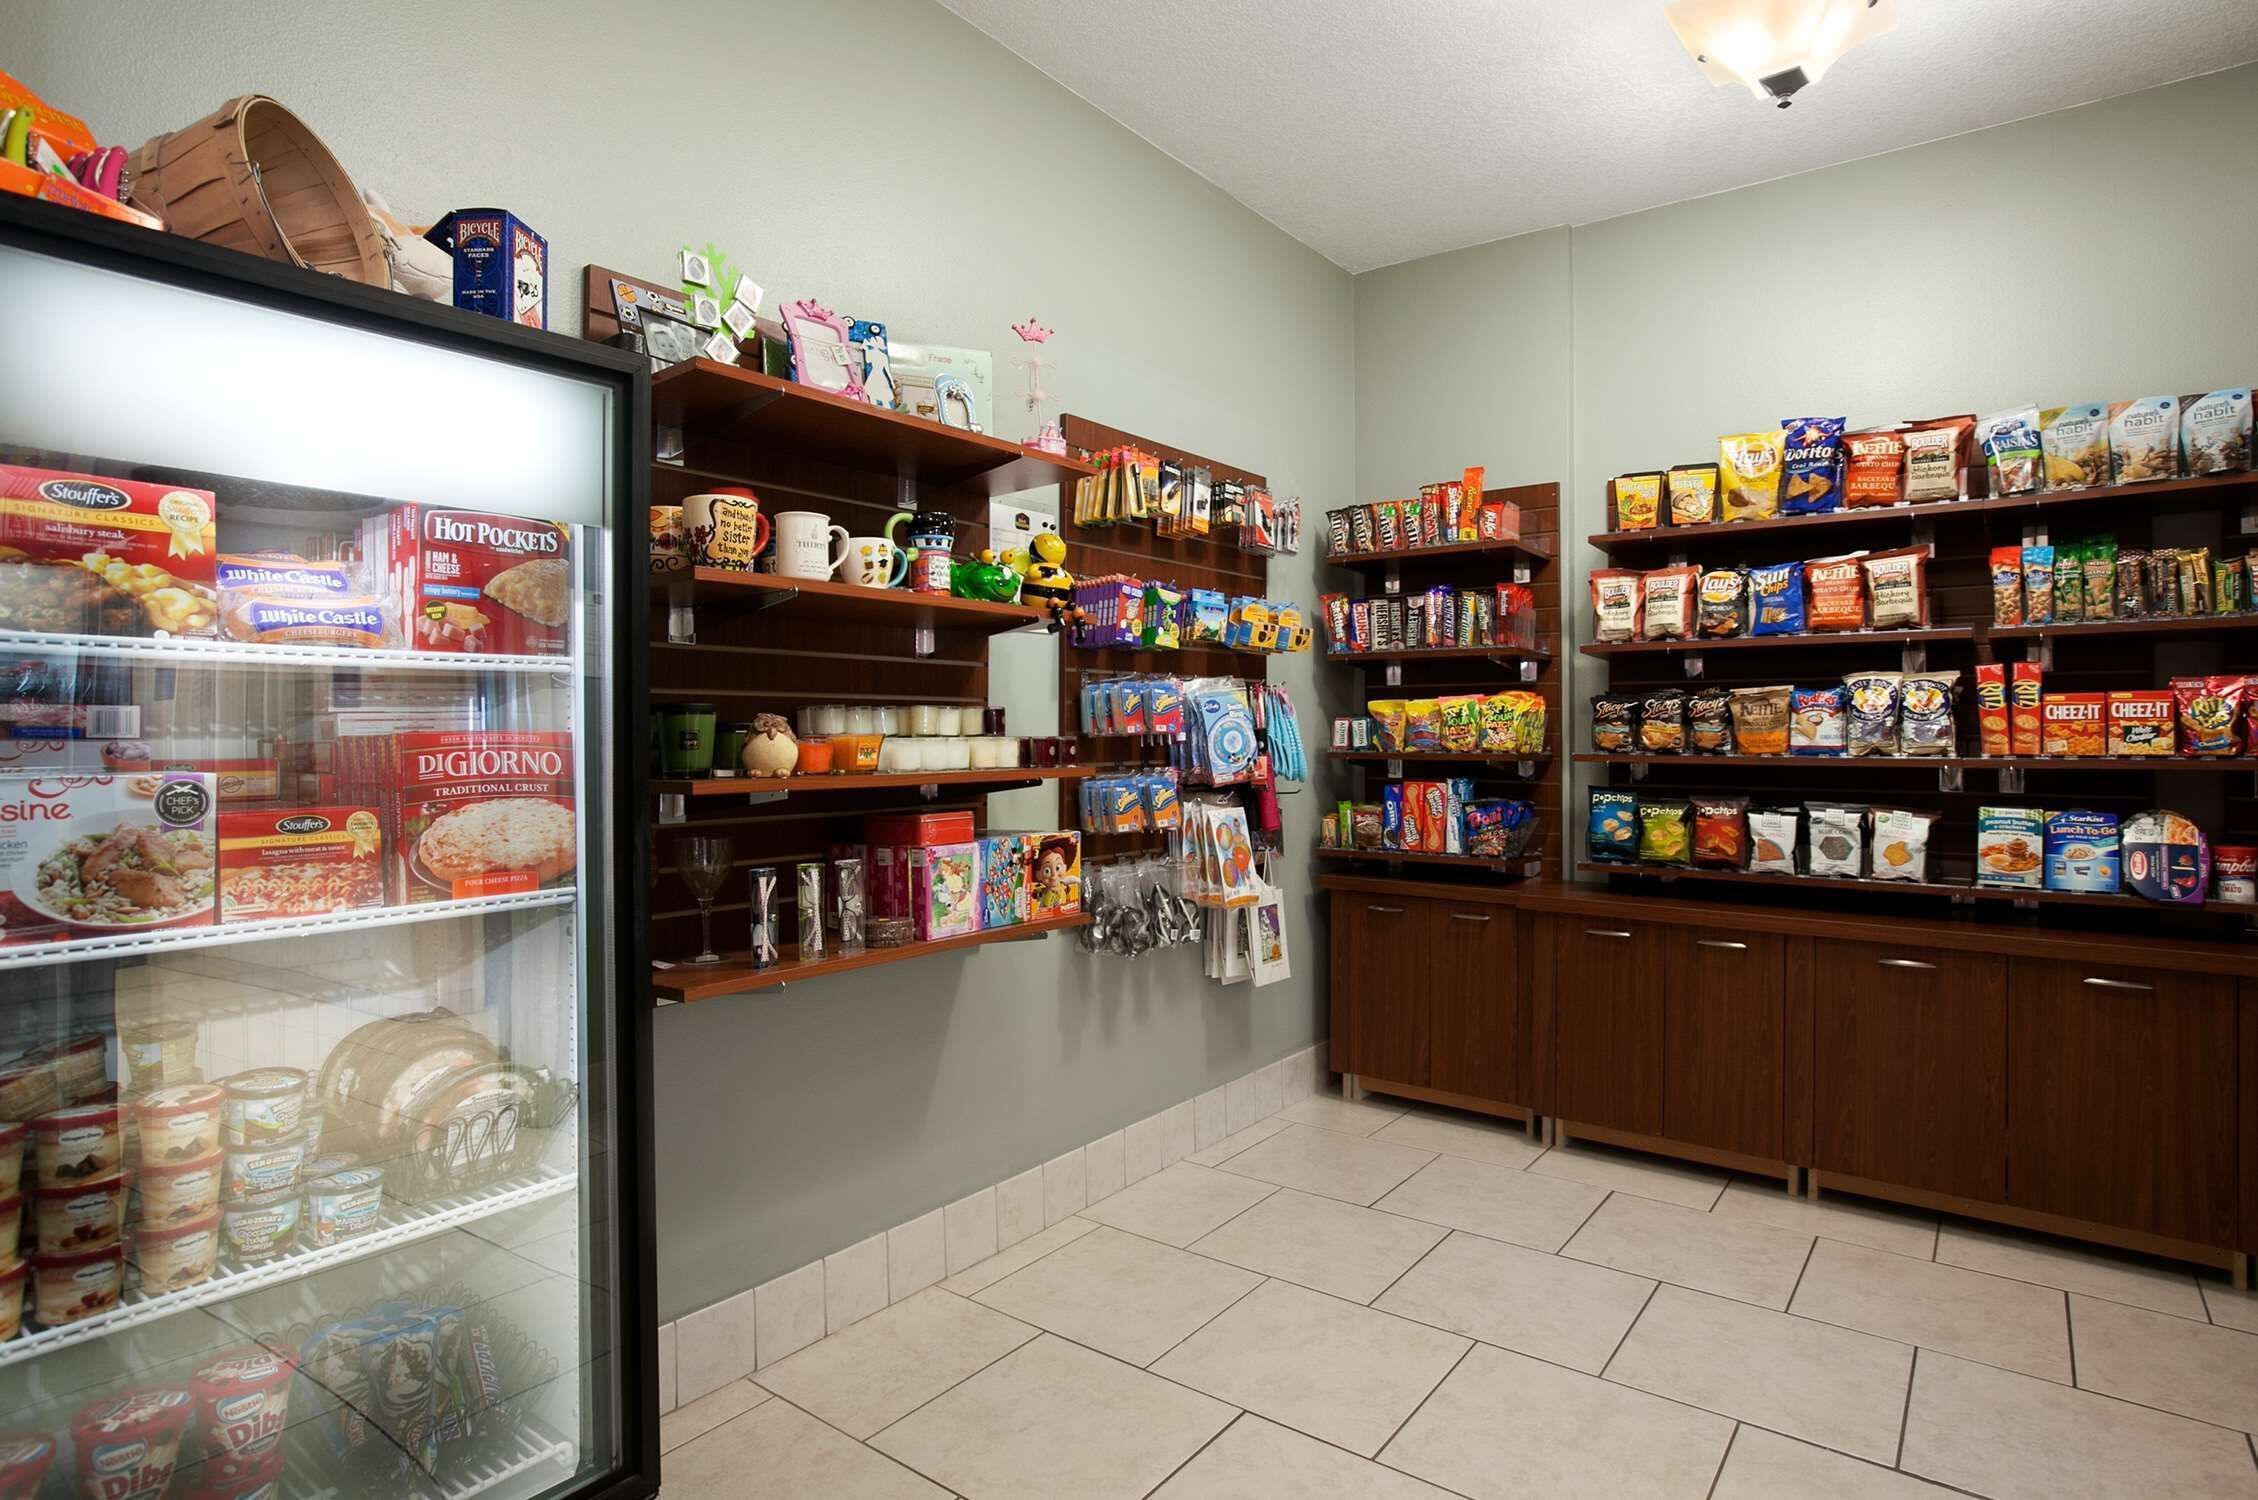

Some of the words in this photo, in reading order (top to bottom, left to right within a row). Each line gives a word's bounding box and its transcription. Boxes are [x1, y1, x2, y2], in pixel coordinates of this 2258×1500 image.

[460, 221, 501, 243] BICYCLE
[515, 230, 544, 272] BICYCLE
[2193, 405, 2236, 420] habit
[2057, 421, 2094, 436] habit
[2124, 414, 2164, 428] habit
[50, 484, 121, 506] Stouffer's
[95, 512, 155, 528] CLASSICS
[720, 519, 731, 528] no
[44, 522, 95, 538] salisbury
[96, 528, 126, 540] steak
[434, 516, 476, 544] HOT
[477, 521, 559, 553] POCKETS
[722, 531, 751, 545] Sister
[718, 542, 738, 555] than
[432, 551, 450, 564] HAM
[451, 553, 458, 563] &
[432, 562, 462, 575] CHEESE
[226, 568, 286, 586] White
[284, 569, 346, 588] Castle
[1755, 567, 1791, 590] Sun
[1759, 580, 1789, 597] Chips
[260, 609, 319, 625] White
[317, 610, 380, 626] Castle
[1355, 603, 1369, 647] CRUNCH
[2045, 704, 2102, 720] CHEEZ-IT
[2111, 702, 2171, 718] CHEEZ-IT
[434, 784, 513, 798] TRADITIONAL
[514, 783, 550, 793] CRUST
[1592, 793, 1633, 804] popchips
[171, 805, 194, 815] PICK
[282, 818, 325, 833] Stouffer's
[2069, 815, 2105, 823] StarKist
[2050, 825, 2085, 835] Lunch
[2085, 826, 2117, 835] To-Go
